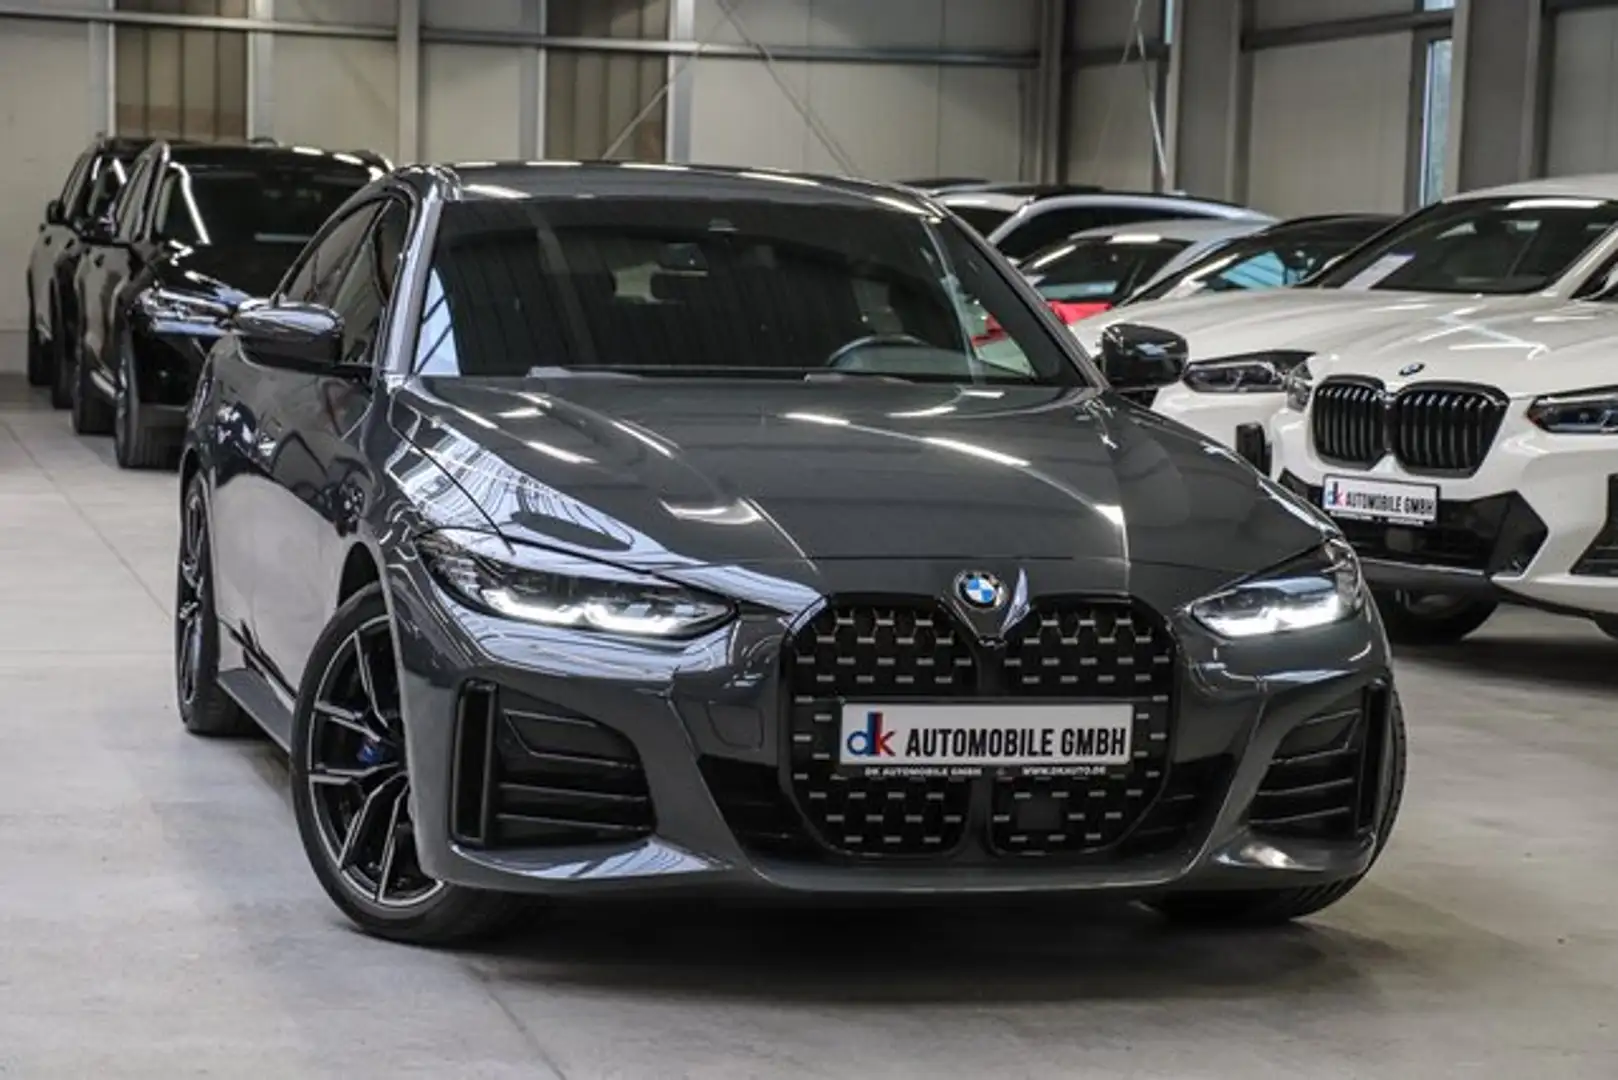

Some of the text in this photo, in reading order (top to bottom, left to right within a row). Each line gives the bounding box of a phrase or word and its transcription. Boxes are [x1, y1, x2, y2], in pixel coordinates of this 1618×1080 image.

[1346, 491, 1402, 512] AUTOMOBILE
[905, 728, 1053, 758] AUTOMOBILE
[1061, 727, 1126, 757] GMBH
[882, 767, 947, 776] AUTOMOBILE
